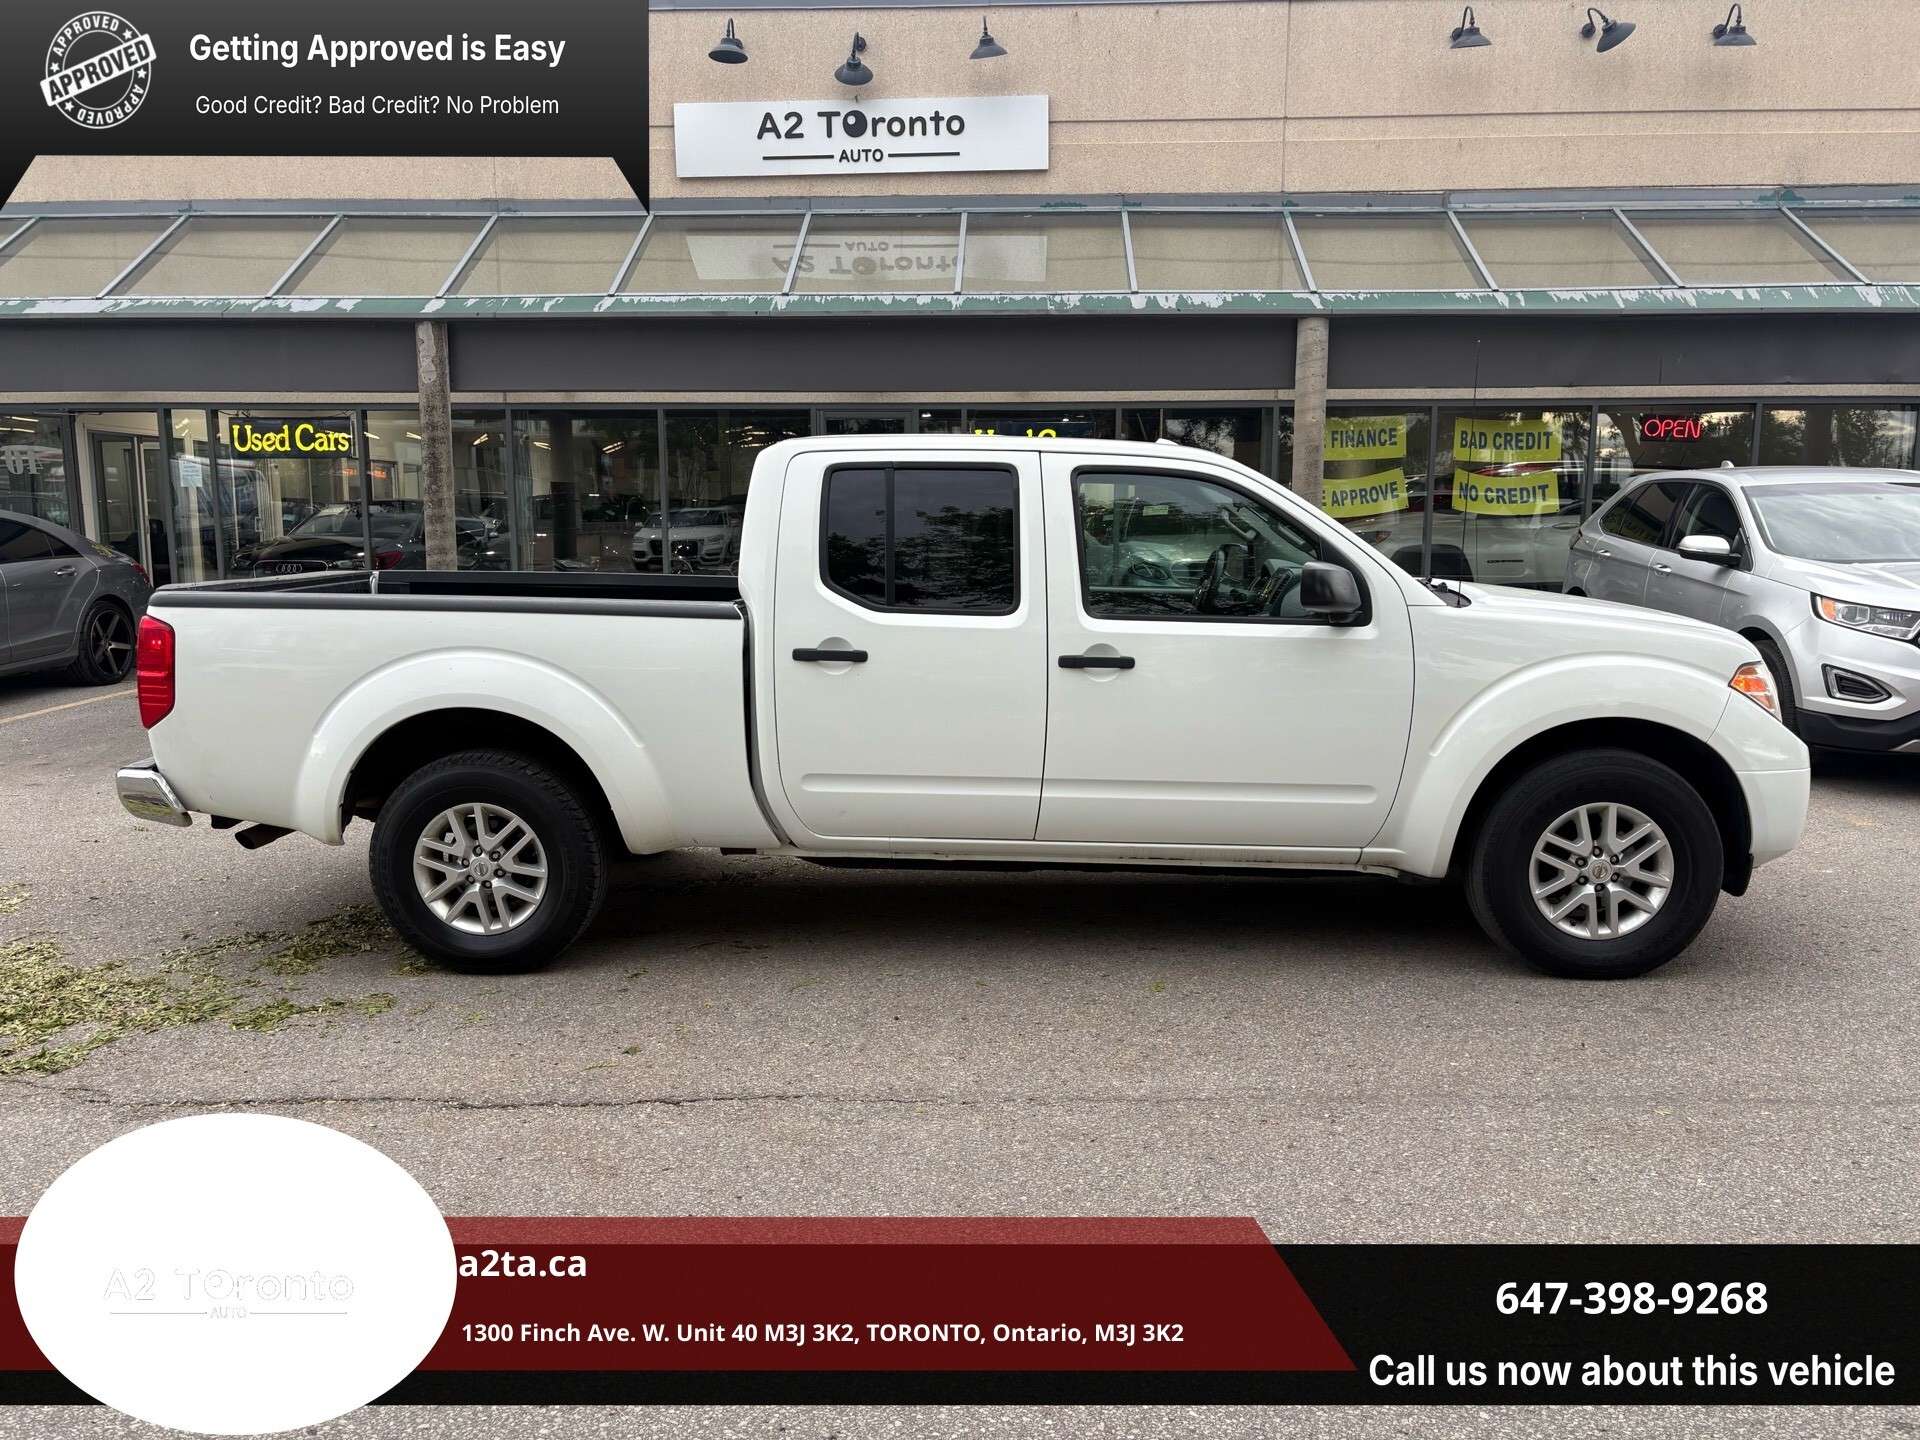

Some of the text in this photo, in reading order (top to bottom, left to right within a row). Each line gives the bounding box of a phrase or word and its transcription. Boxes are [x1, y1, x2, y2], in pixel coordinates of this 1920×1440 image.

[756, 111, 804, 140] A2
[838, 148, 884, 163] AUTO
[232, 423, 350, 452] Used Cars
[1331, 427, 1398, 449] FINANCE
[1644, 418, 1701, 438] OPEN
[1459, 430, 1554, 450] BAD CREDIT
[1331, 480, 1399, 507] APPROVE
[1458, 481, 1549, 505] NO CREDIT
